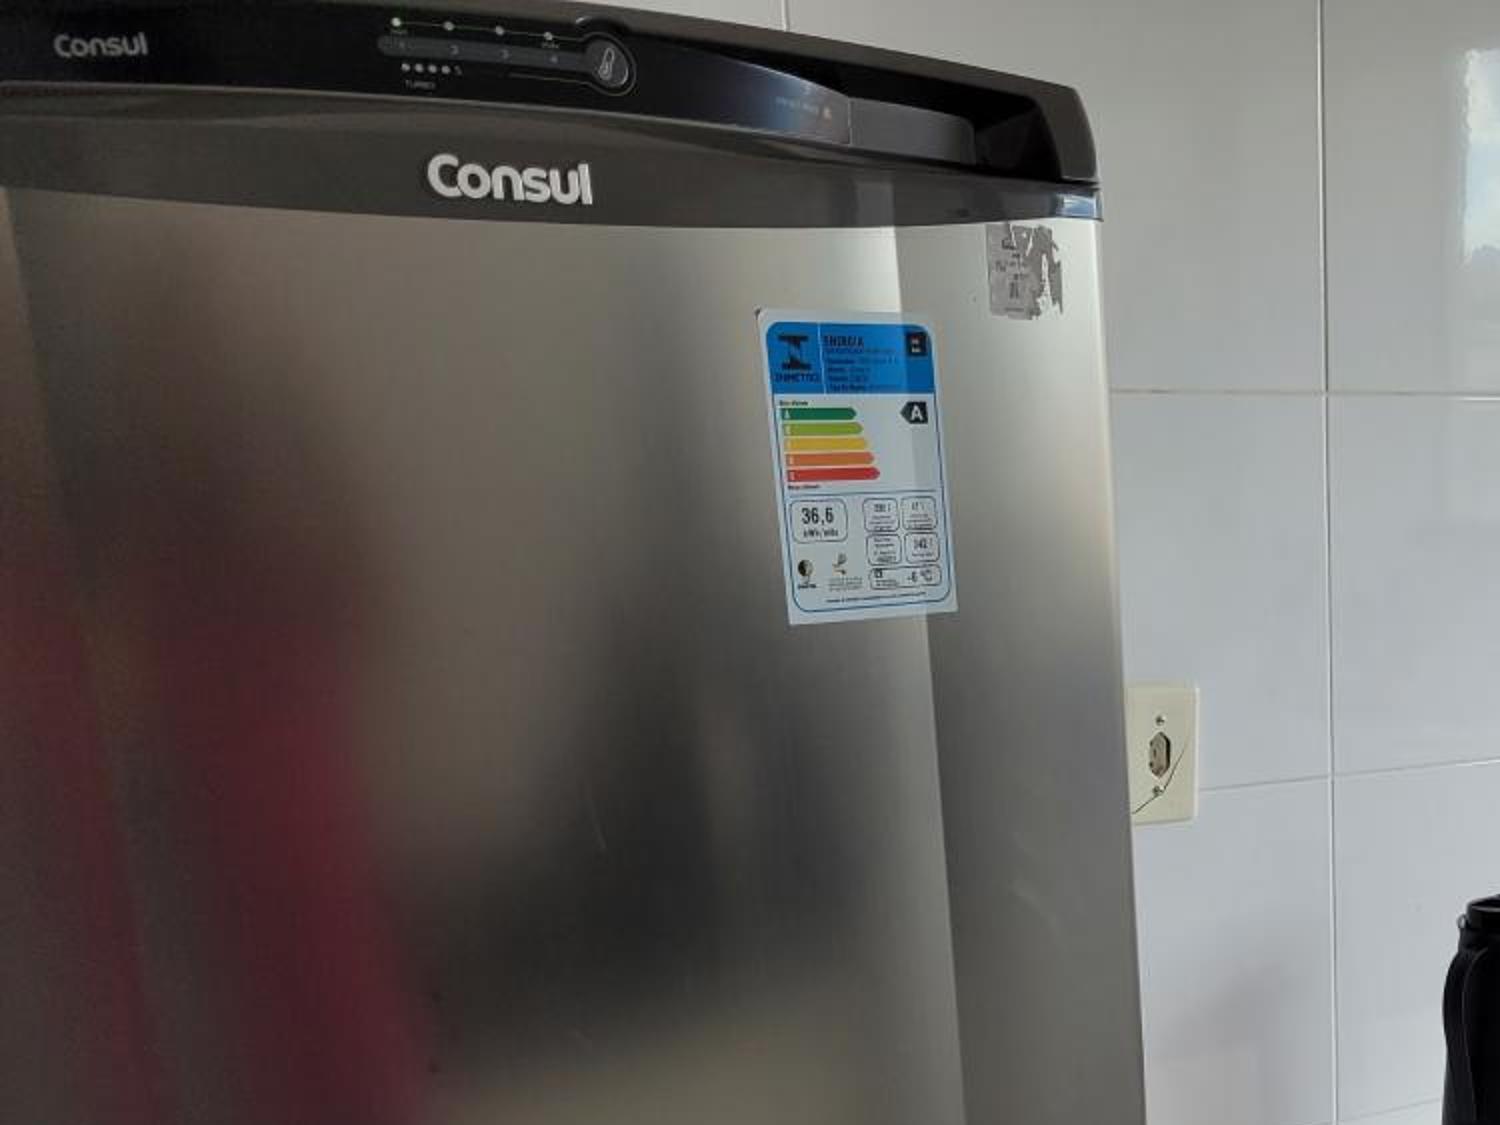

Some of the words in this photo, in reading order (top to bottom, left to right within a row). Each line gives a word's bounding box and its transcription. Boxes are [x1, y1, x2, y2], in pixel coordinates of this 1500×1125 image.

[53, 31, 149, 58] Consul
[427, 152, 593, 205] Consul
[910, 405, 923, 421] A
[801, 507, 834, 525] 36,6
